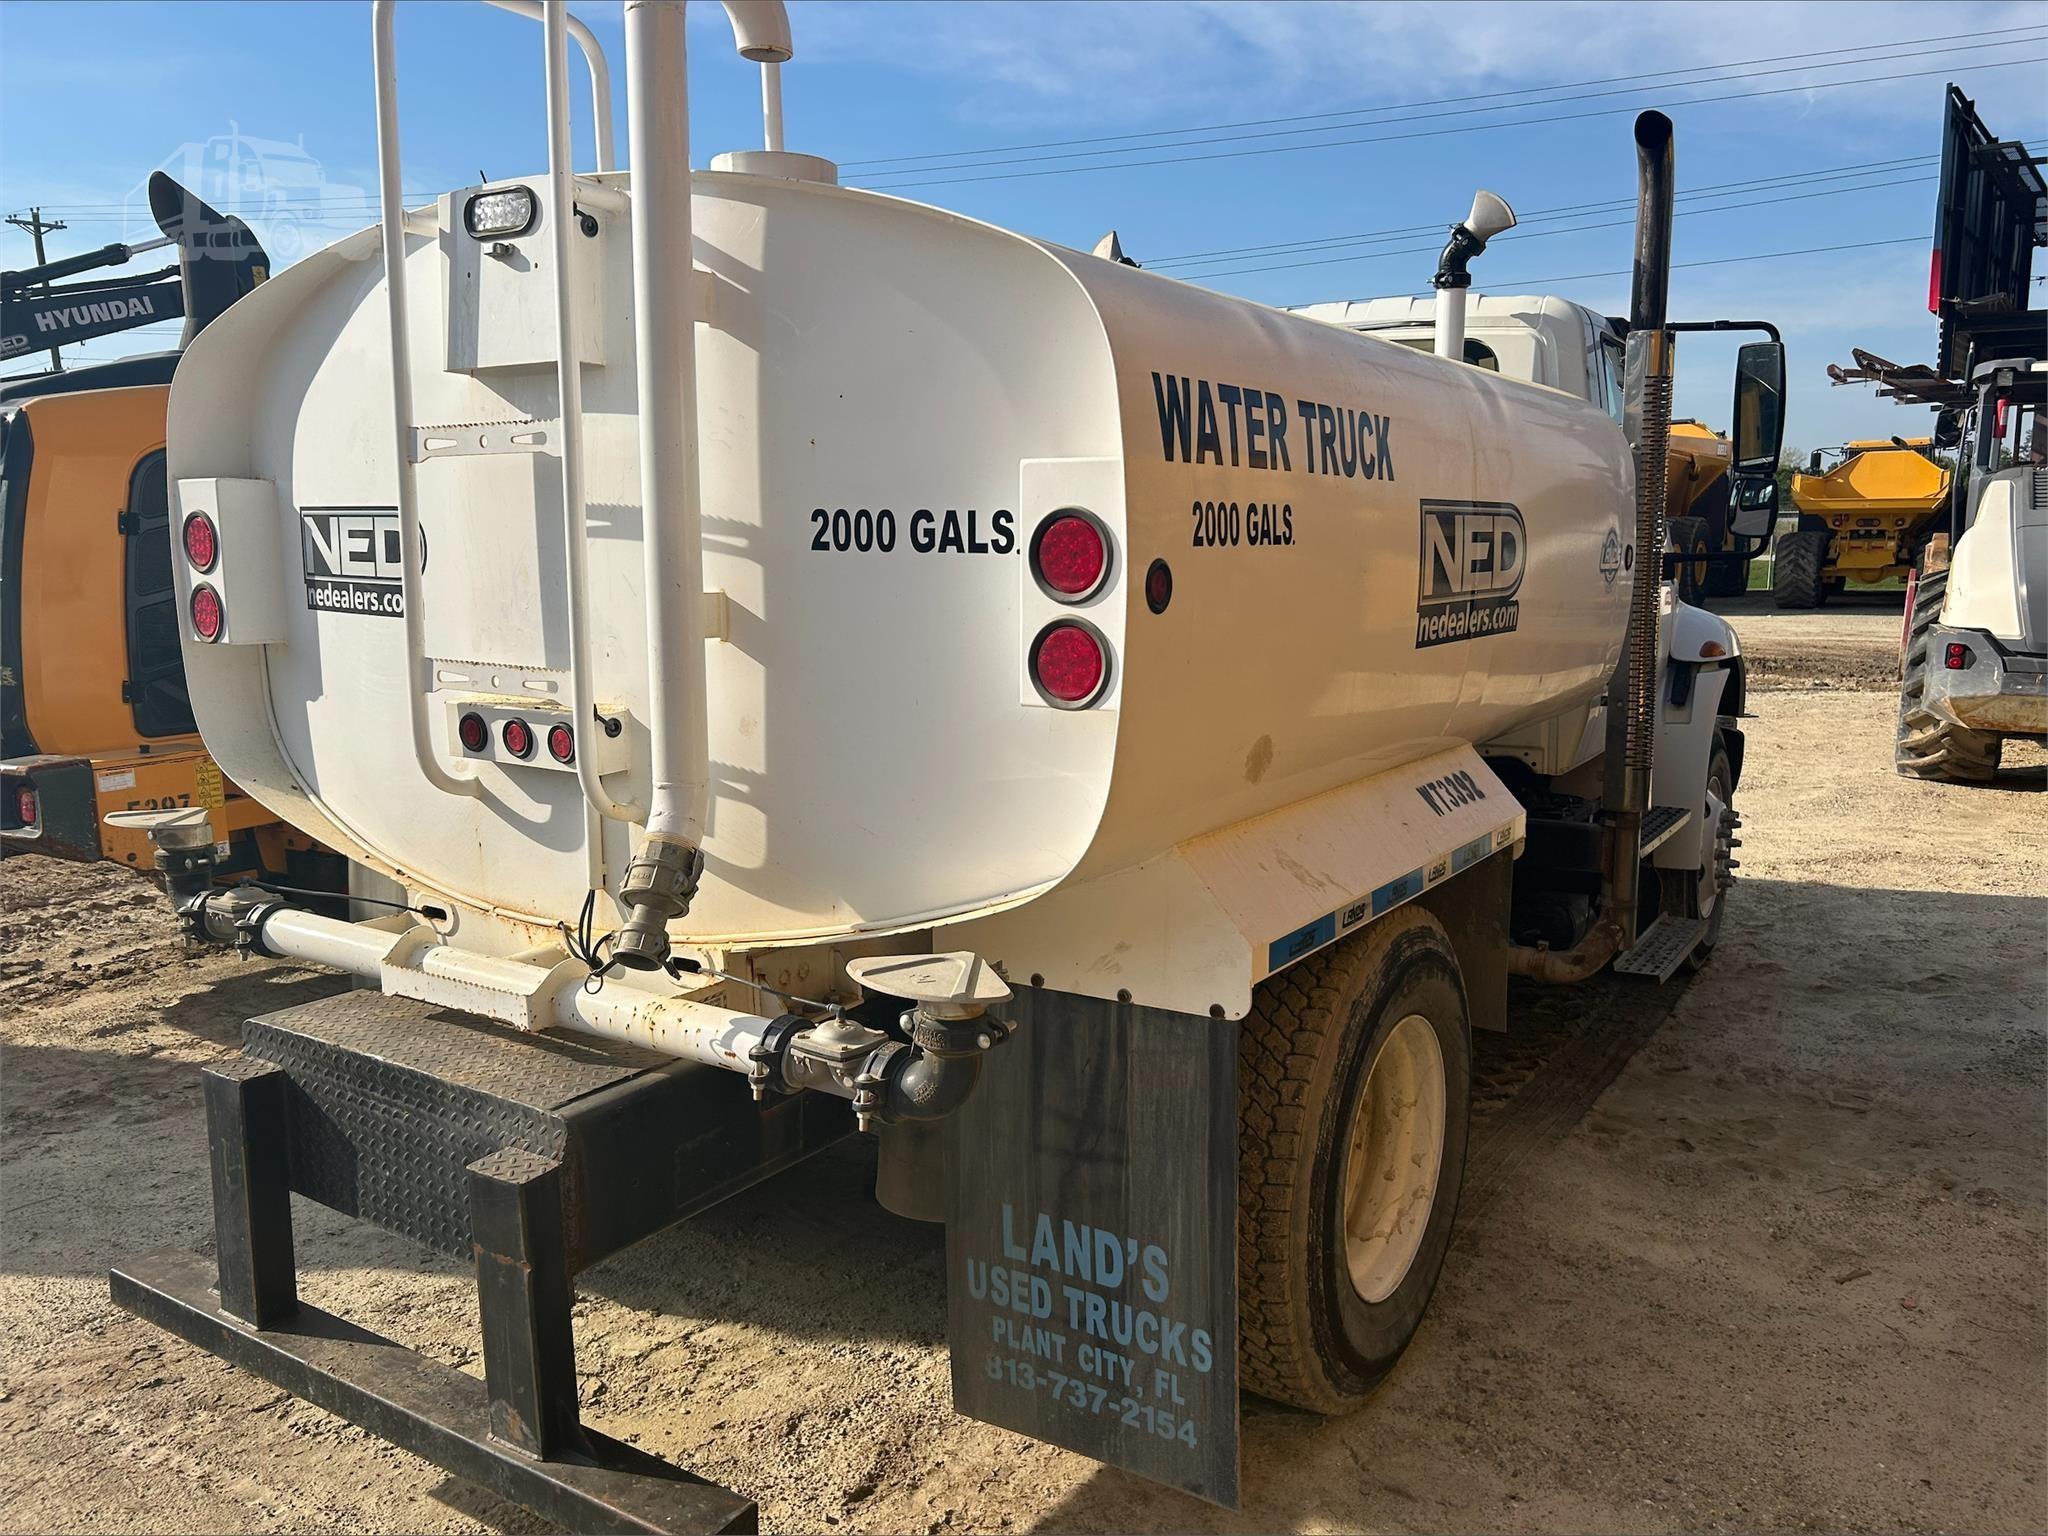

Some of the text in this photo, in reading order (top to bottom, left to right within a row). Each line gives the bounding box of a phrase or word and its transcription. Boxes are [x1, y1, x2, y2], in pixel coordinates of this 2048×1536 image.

[0, 334, 29, 352] ED
[34, 296, 154, 332] HYUNDAI
[1151, 372, 1395, 482] WATER TRUCK
[811, 508, 1021, 555] 2000 GALS.
[1192, 501, 1296, 547] 2000 GALS.
[1423, 513, 1524, 596] NED
[308, 582, 404, 613] nedealers.co
[1418, 601, 1517, 642] nedealers.com
[1002, 1201, 1169, 1303] LAND'S
[967, 1258, 1212, 1373] USED TRUCKS
[992, 1315, 1185, 1405] PLANT CITY, FL
[985, 1356, 1198, 1449] 813-737-2154
